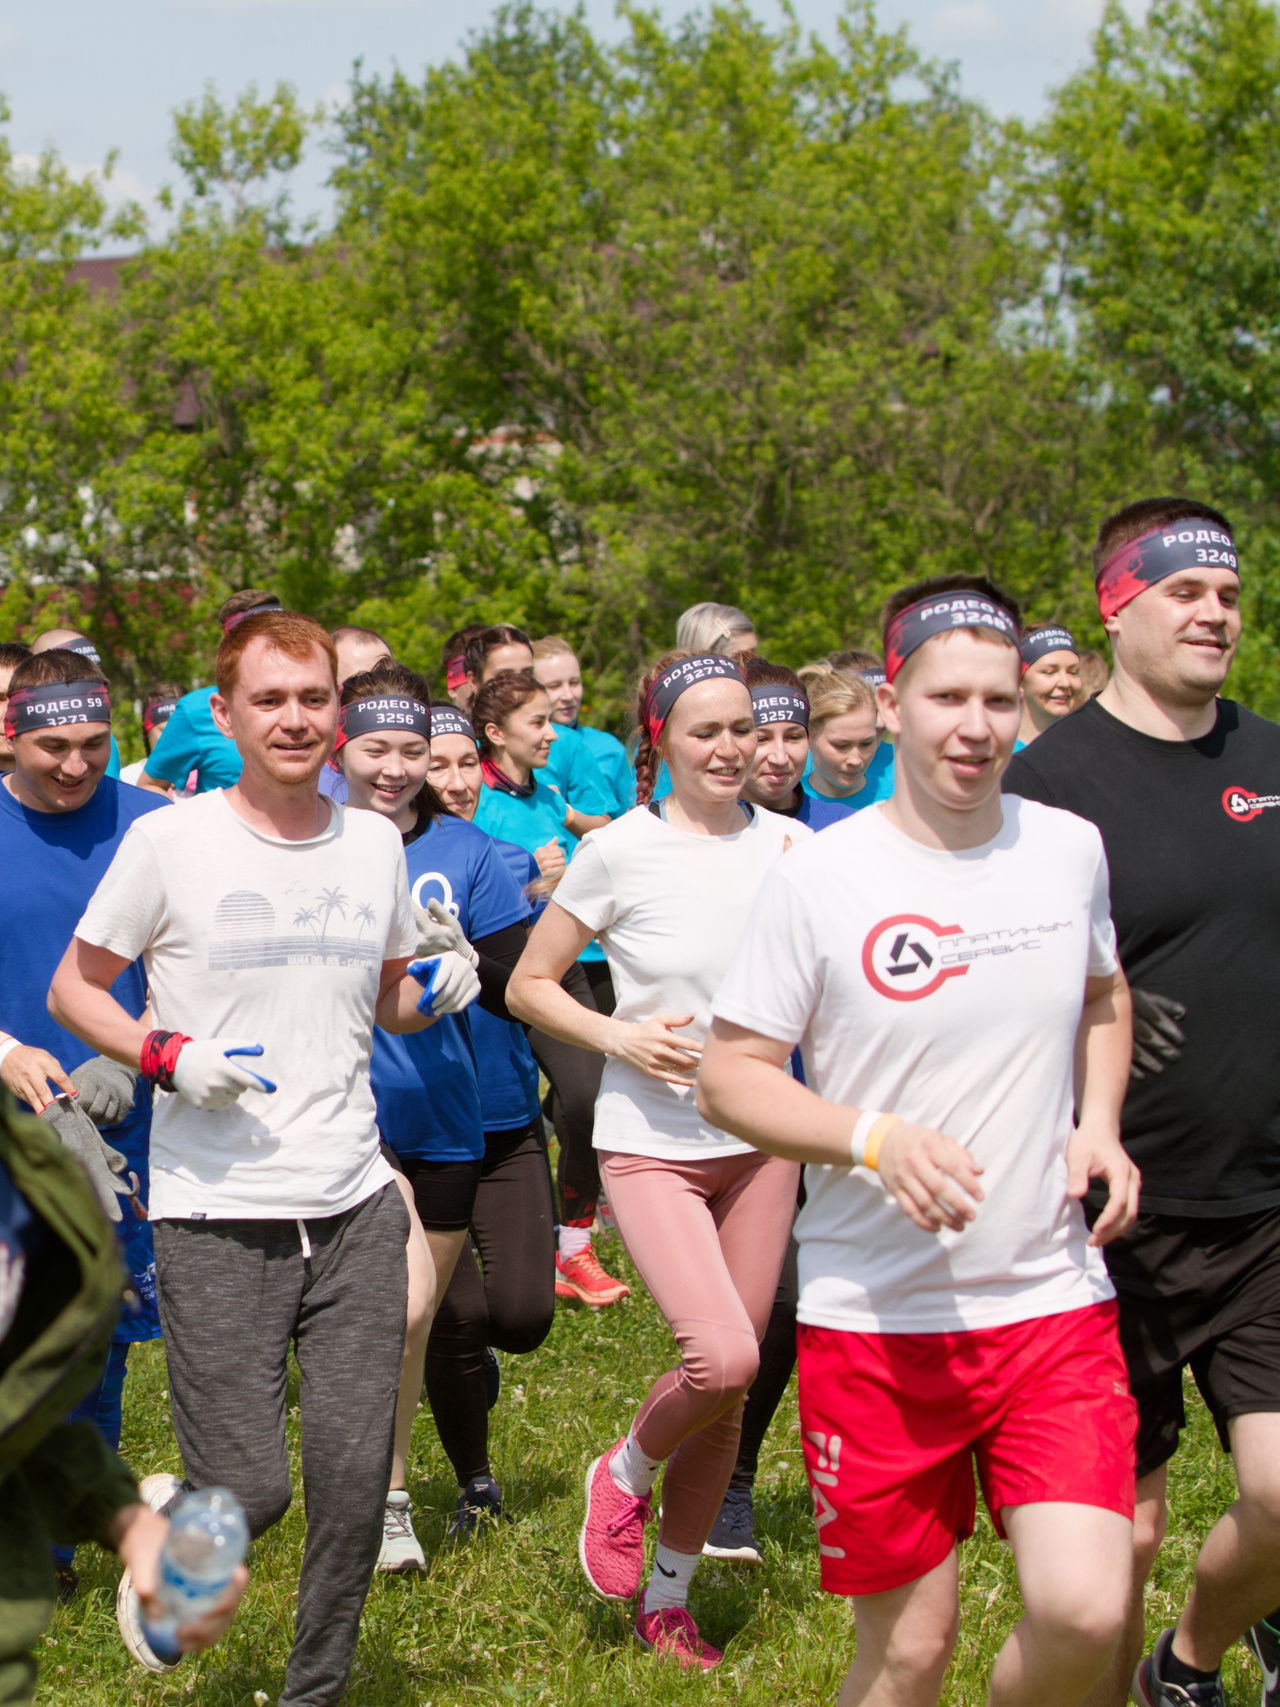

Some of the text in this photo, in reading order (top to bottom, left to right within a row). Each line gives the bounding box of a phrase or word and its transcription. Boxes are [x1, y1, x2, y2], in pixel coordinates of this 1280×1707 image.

[1162, 530, 1231, 548] РОДЕО
[1195, 549, 1237, 568] 3249
[921, 599, 995, 621] РОДЕО
[950, 611, 1007, 631] 3248
[662, 657, 715, 689] РОДЕО
[683, 665, 726, 685] 3276
[26, 697, 103, 716] РОДЕО 59
[358, 699, 426, 715] РОДЕО 59
[753, 697, 806, 711] ОДЕО 59
[376, 713, 414, 725] 3256
[759, 710, 794, 724] 3257
[938, 920, 1073, 950] ПЛАТИНУМ
[941, 939, 1042, 965] СЕРВИС
